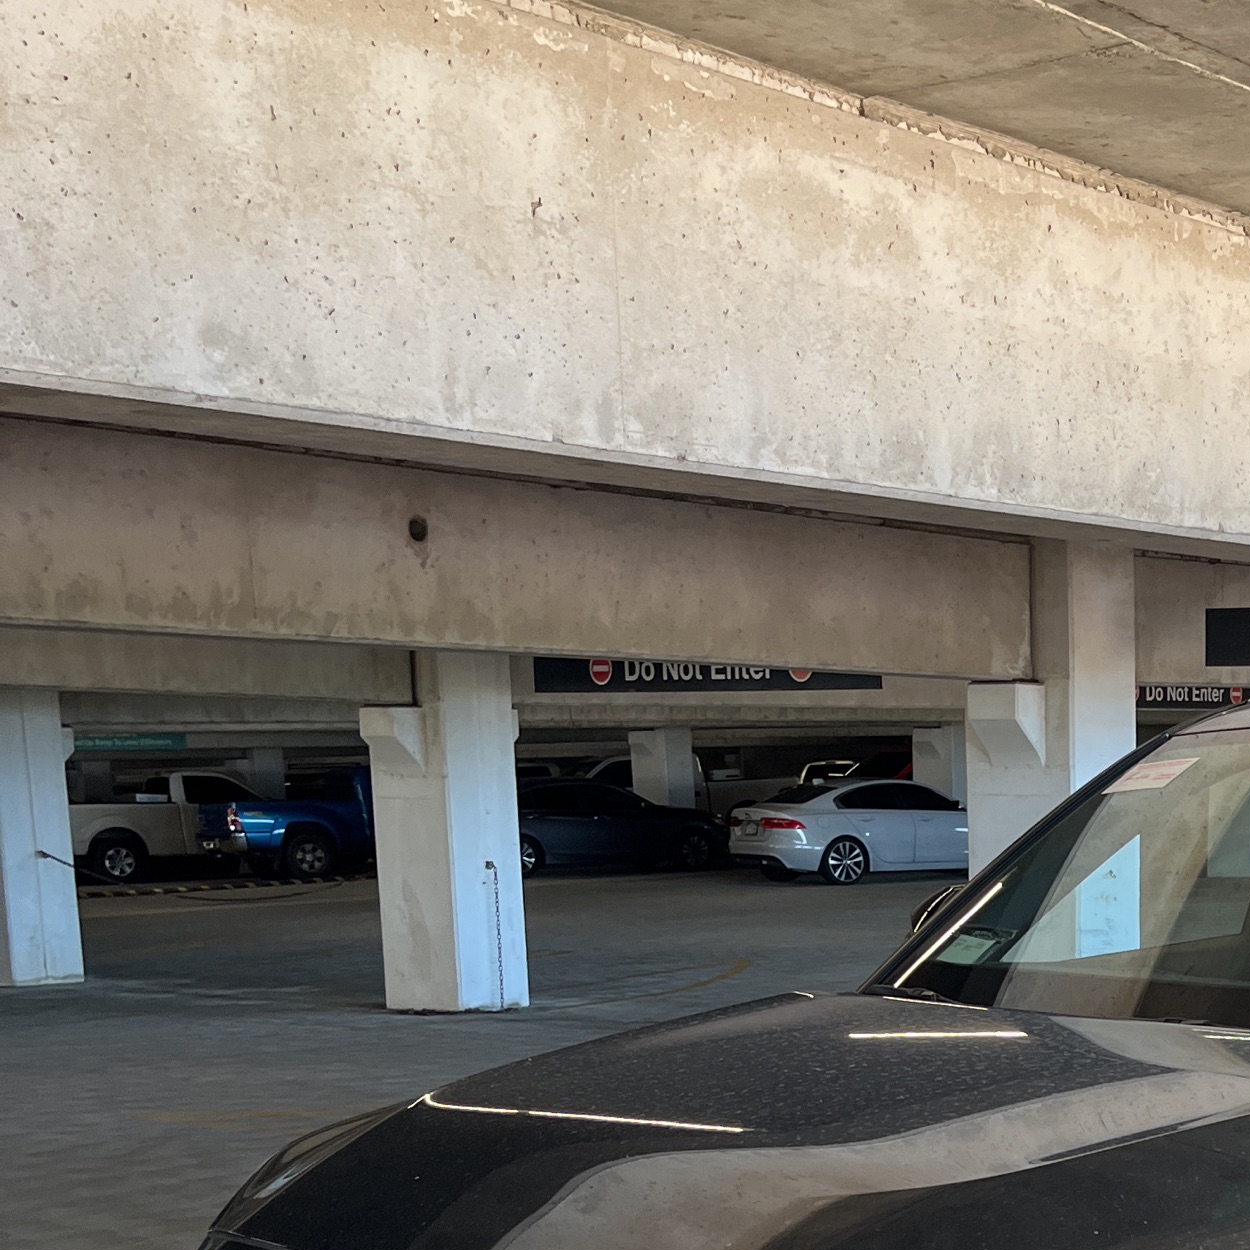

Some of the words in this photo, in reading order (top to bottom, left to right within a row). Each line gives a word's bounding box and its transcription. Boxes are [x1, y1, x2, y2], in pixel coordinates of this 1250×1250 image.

[624, 660, 655, 681] Do
[662, 662, 703, 681] Not
[1145, 686, 1164, 702] Do
[1167, 686, 1189, 702] Not
[1191, 687, 1225, 702] Enter
